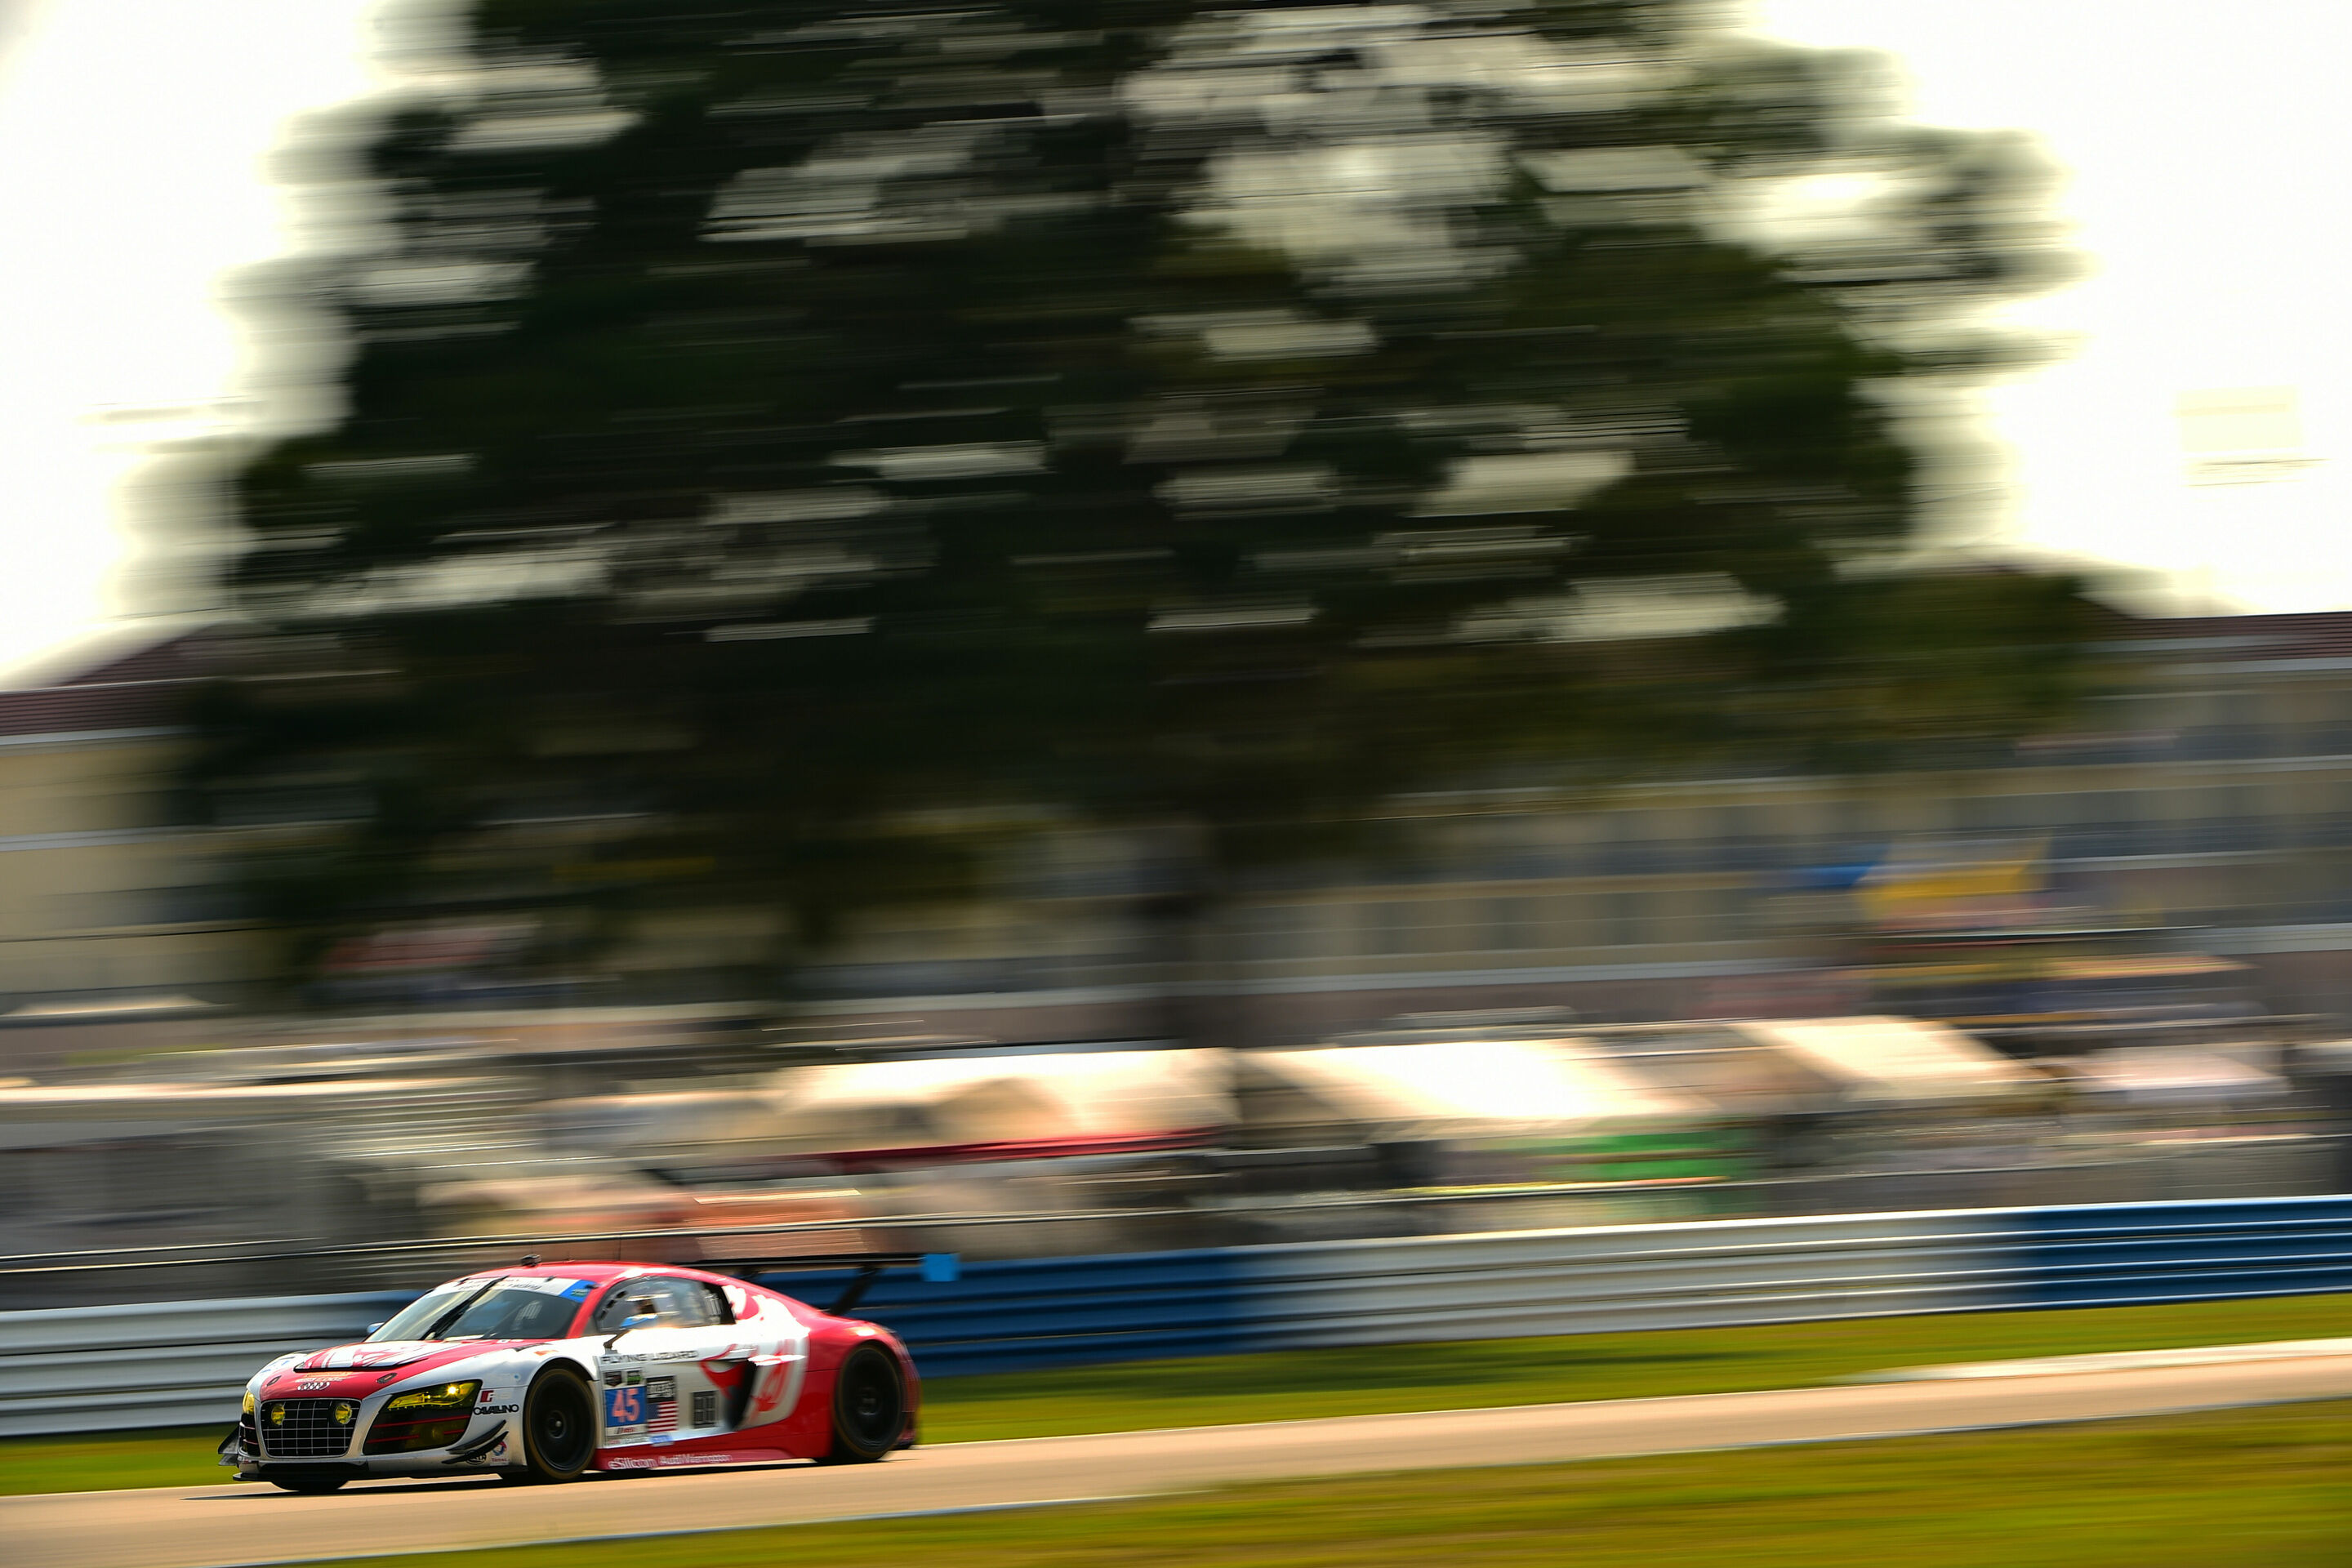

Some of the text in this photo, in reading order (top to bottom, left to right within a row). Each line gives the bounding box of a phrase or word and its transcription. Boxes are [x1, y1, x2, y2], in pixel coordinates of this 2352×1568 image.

[601, 1350, 699, 1363] FLYING LIZARD
[612, 1388, 640, 1423] 45
[608, 1457, 657, 1469] eSilicon
